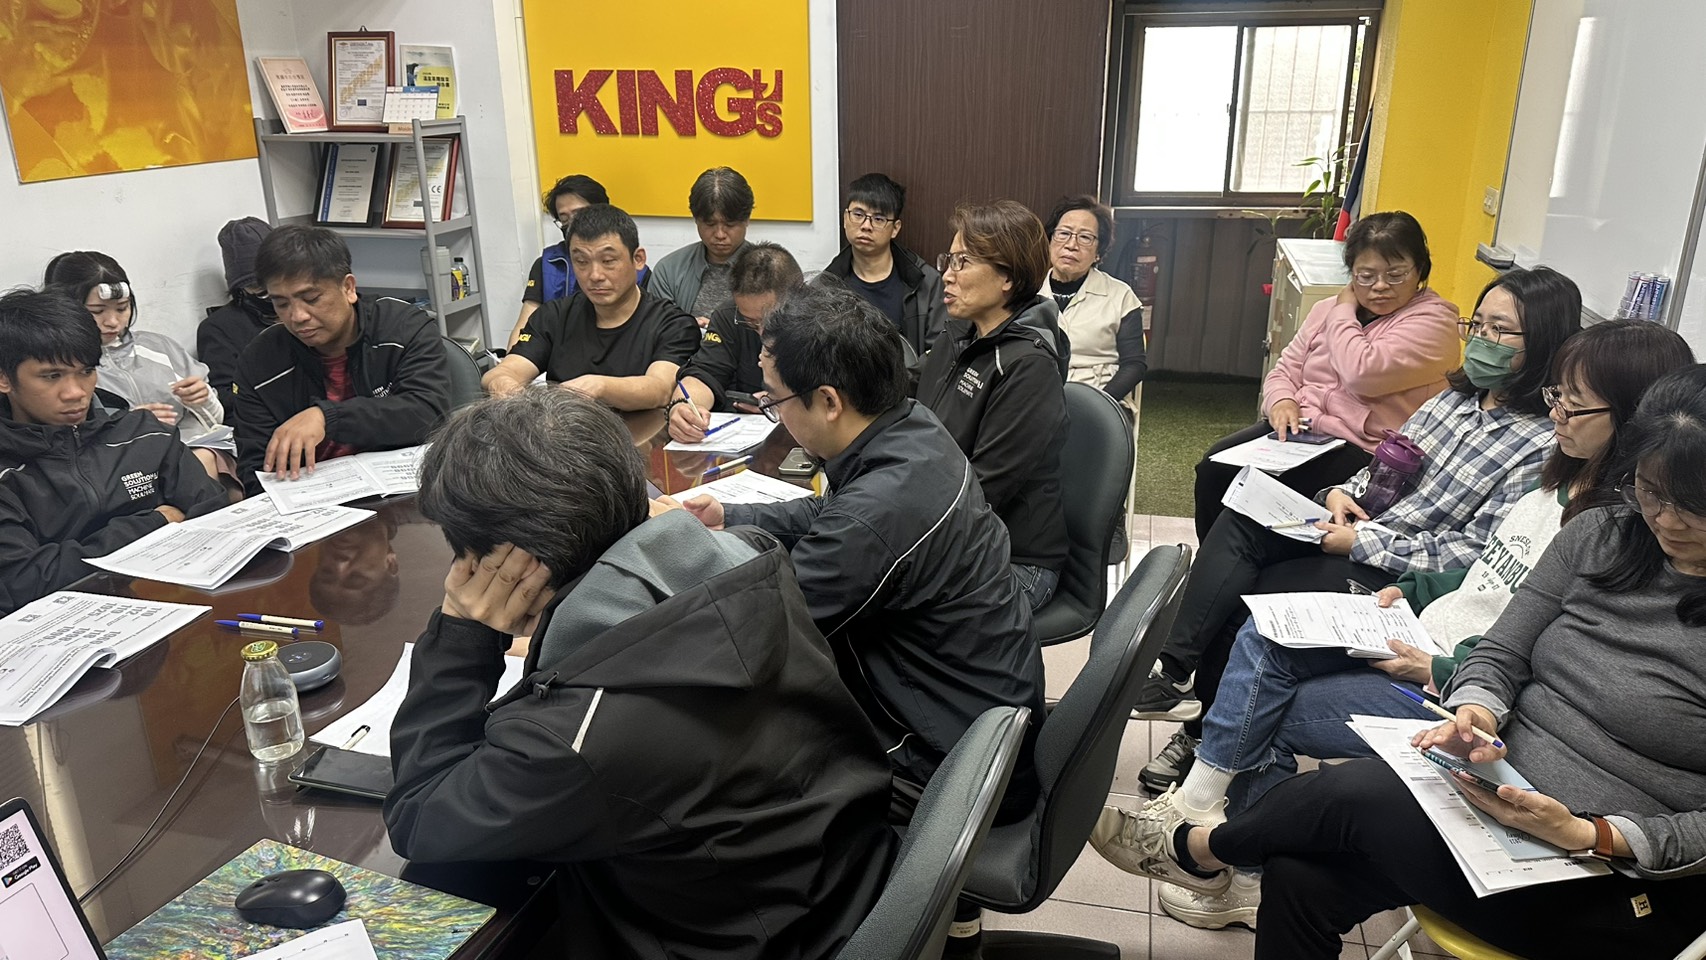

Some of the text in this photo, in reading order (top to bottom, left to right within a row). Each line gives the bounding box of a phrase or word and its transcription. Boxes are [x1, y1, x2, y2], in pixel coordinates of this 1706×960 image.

[431, 185, 441, 193] CE
[121, 471, 143, 482] GREEN
[126, 606, 147, 616] 112
[141, 607, 162, 618] 110
[14, 869, 30, 880] Google
